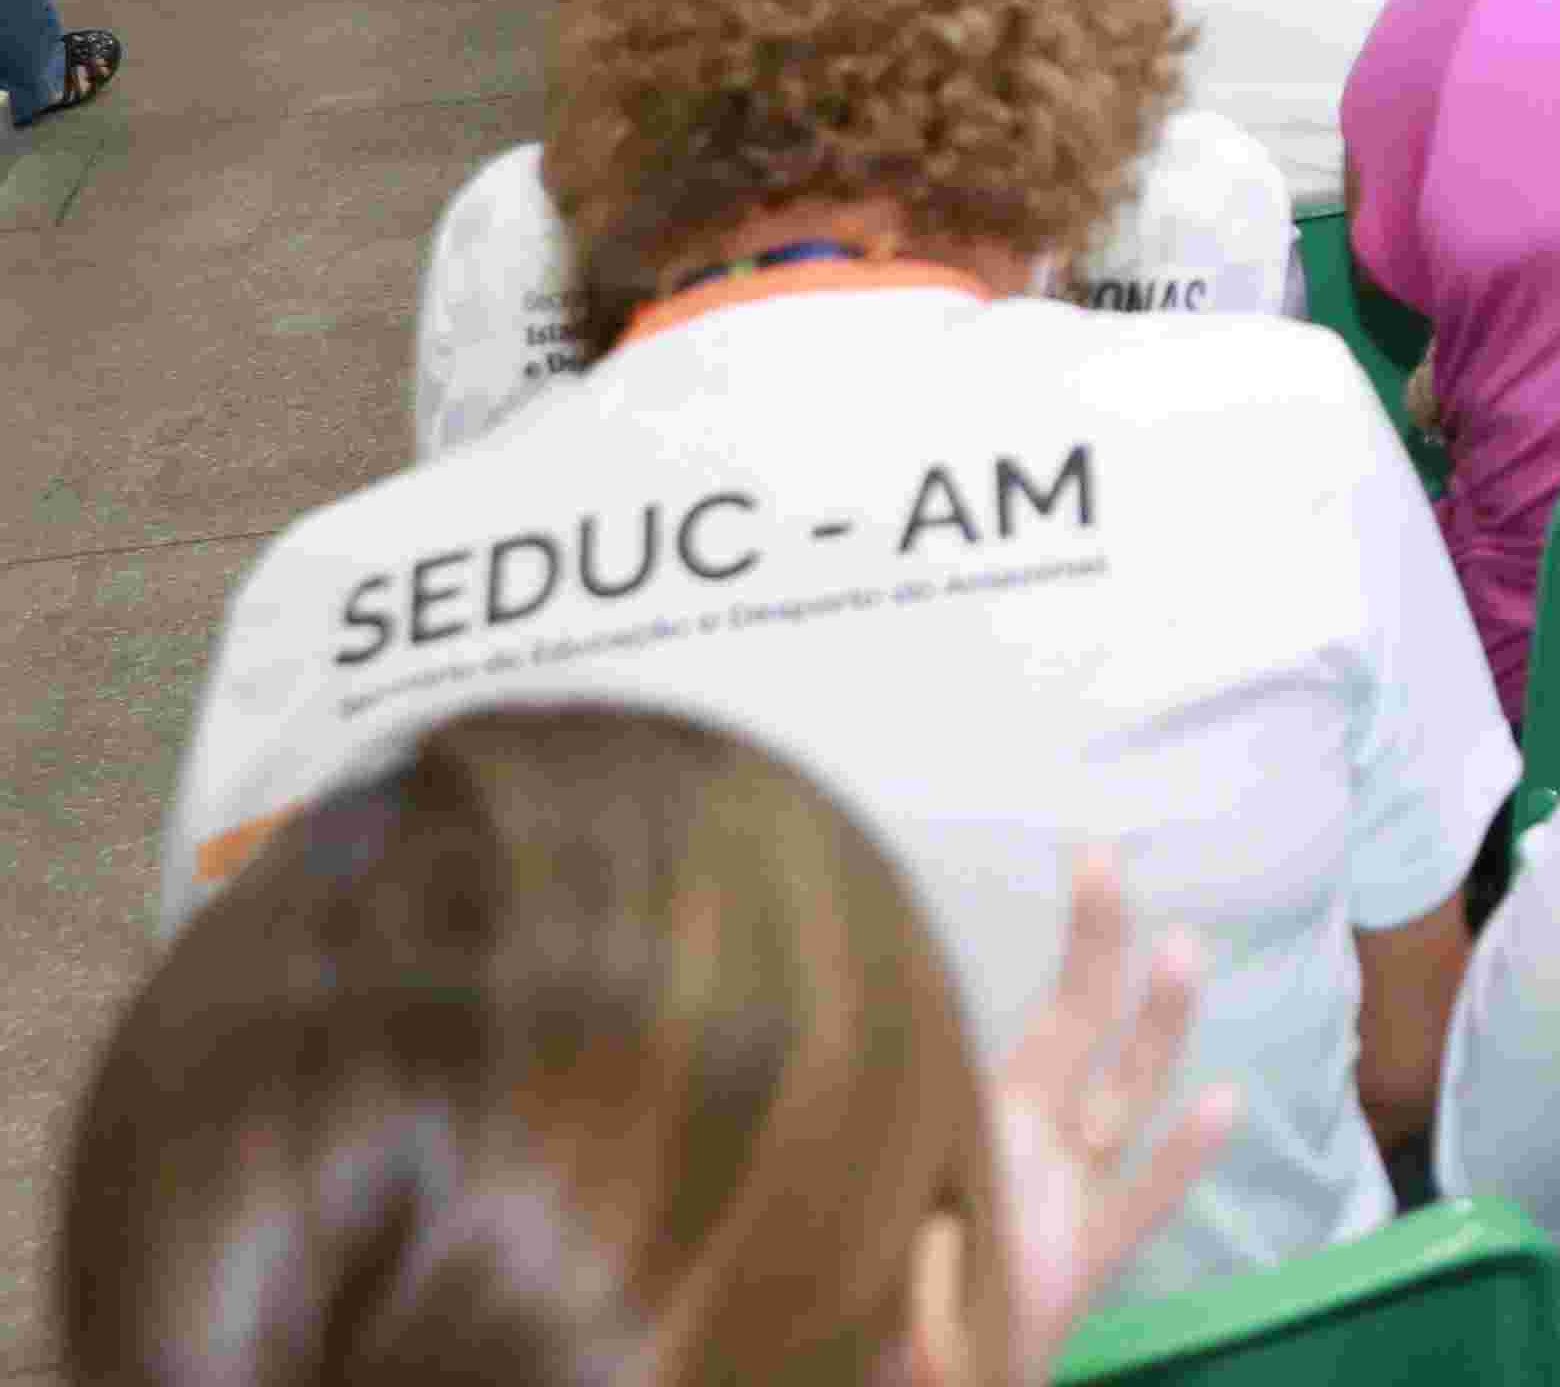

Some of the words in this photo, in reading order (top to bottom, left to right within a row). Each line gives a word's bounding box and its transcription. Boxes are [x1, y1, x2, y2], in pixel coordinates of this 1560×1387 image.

[333, 491, 760, 665] SEDUC
[811, 520, 852, 538] -
[898, 443, 1093, 554] AM
